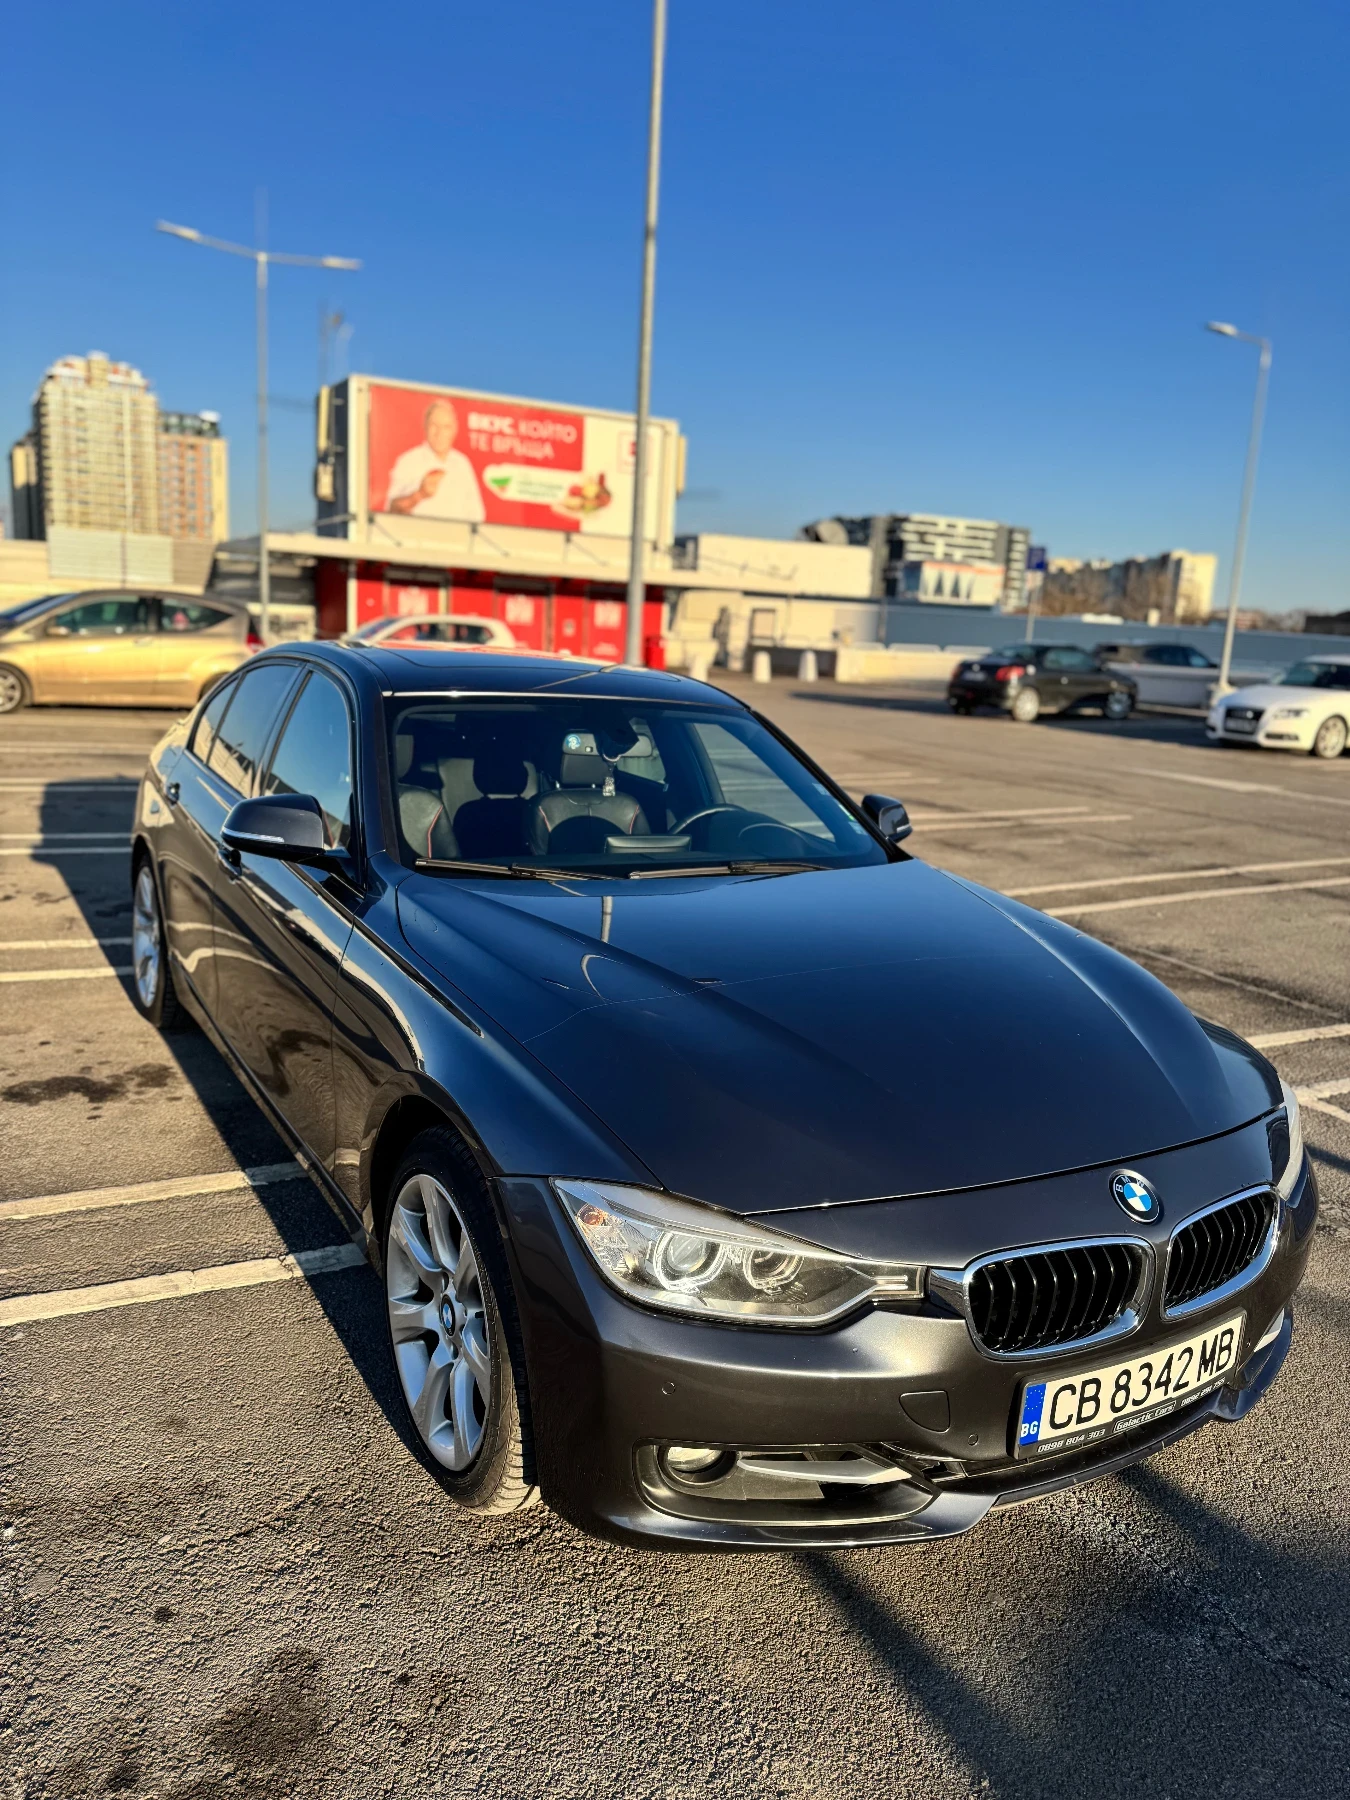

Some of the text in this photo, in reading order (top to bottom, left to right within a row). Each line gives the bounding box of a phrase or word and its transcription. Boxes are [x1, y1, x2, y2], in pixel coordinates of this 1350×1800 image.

[469, 431, 490, 453] ТЕ
[1115, 1175, 1146, 1193] BMW
[1049, 1327, 1235, 1430] CB 8342 MB
[1020, 1420, 1038, 1437] BG
[1116, 1404, 1175, 1430] Galactic Cars
[1037, 1428, 1106, 1453] 0898 804 303
